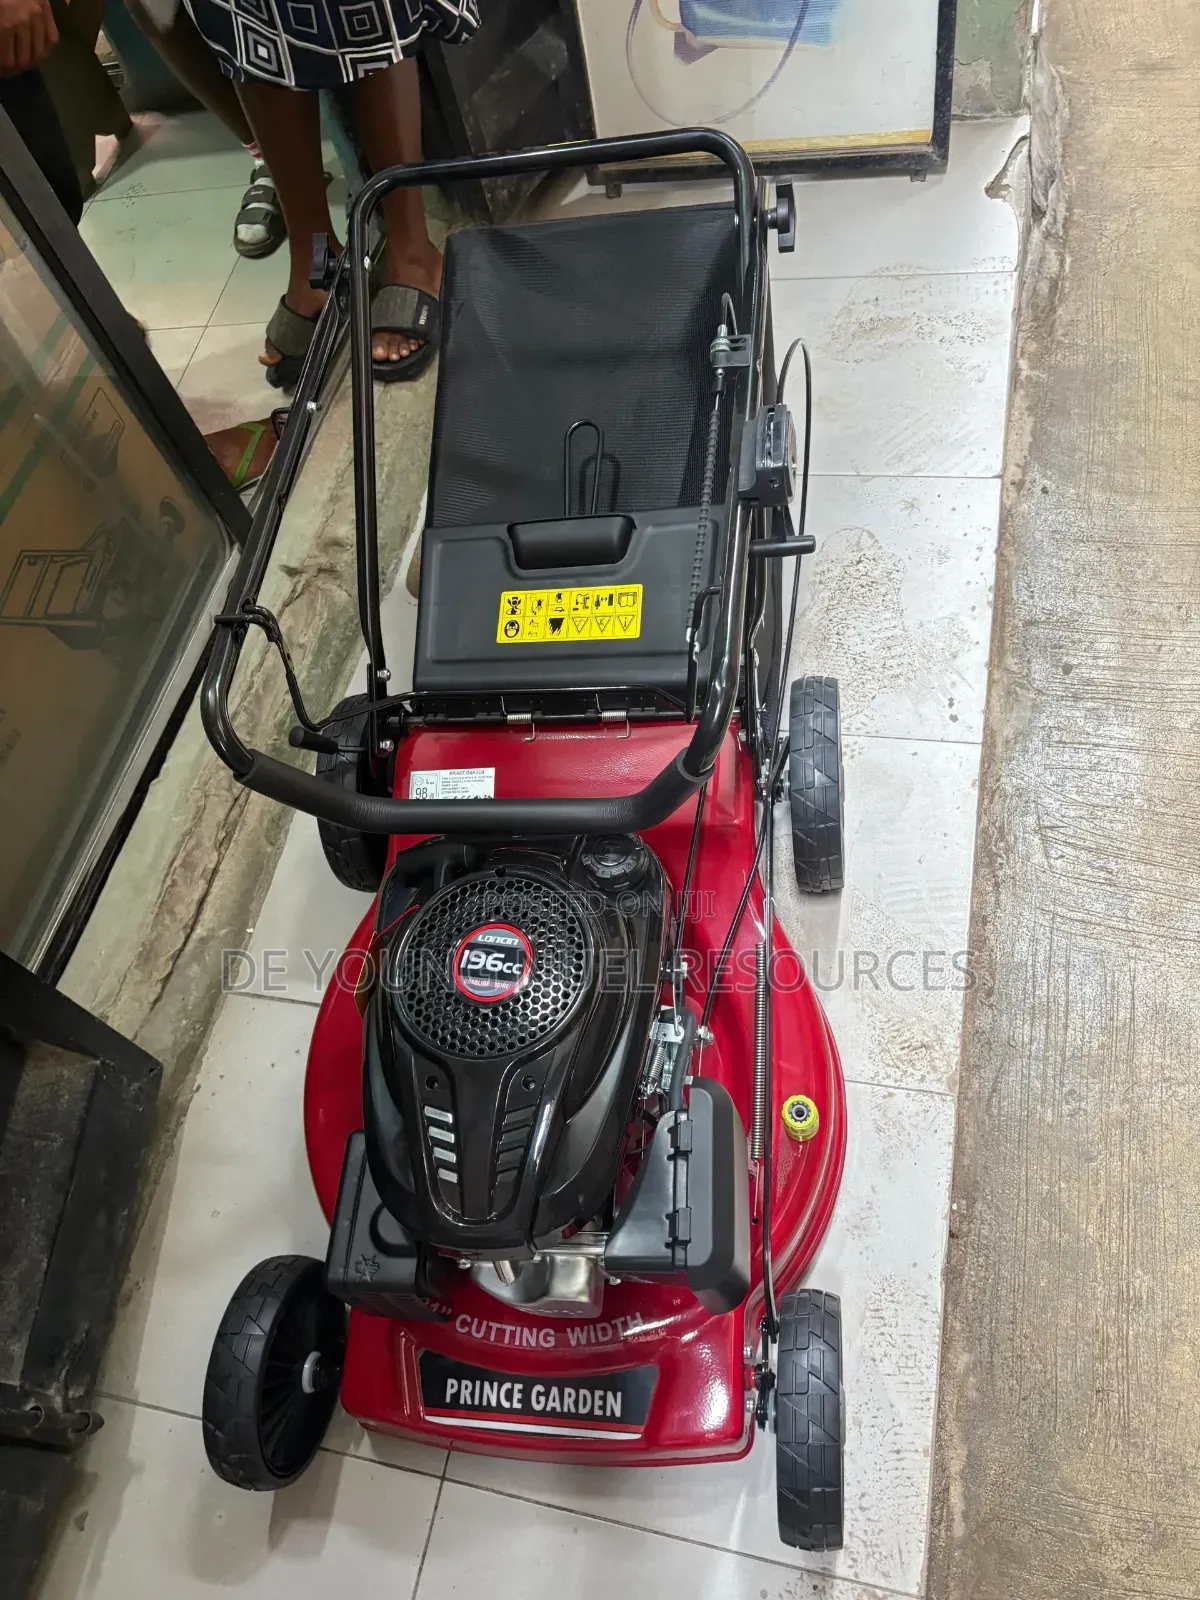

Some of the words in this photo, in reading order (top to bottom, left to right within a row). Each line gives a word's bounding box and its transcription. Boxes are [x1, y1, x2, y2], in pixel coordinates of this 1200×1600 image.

[415, 787, 428, 799] 98
[460, 949, 524, 975] 196cc
[455, 1314, 556, 1348] CUTTING
[566, 1311, 645, 1348] WIDTH
[444, 1377, 524, 1410] PRINCE
[530, 1383, 622, 1418] GARDEN
